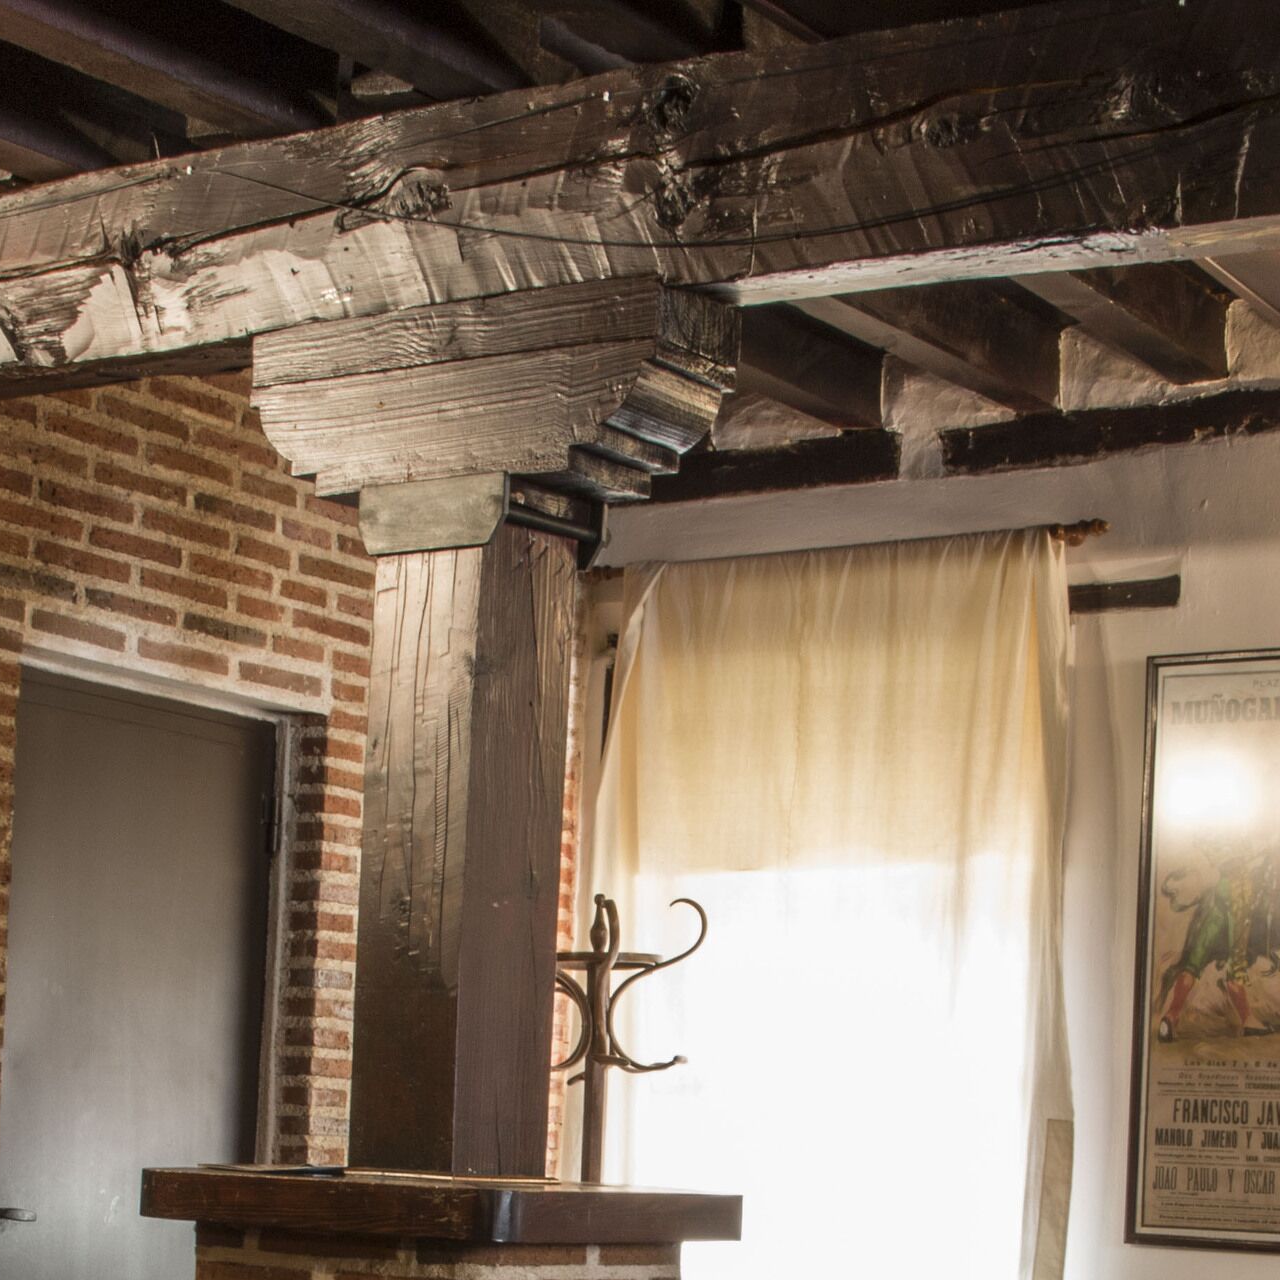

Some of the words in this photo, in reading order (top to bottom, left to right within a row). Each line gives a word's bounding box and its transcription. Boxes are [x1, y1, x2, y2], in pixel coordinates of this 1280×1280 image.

[1173, 1099, 1249, 1124] FRANCISCO
[1155, 1128, 1193, 1147] MANOLO
[1201, 1129, 1238, 1149] JIMENO
[1246, 1131, 1253, 1149] Y
[1153, 1166, 1177, 1190] JOAO
[1187, 1168, 1218, 1193] PAULO
[1227, 1168, 1234, 1193] Y
[1244, 1169, 1275, 1195] OSCAR
